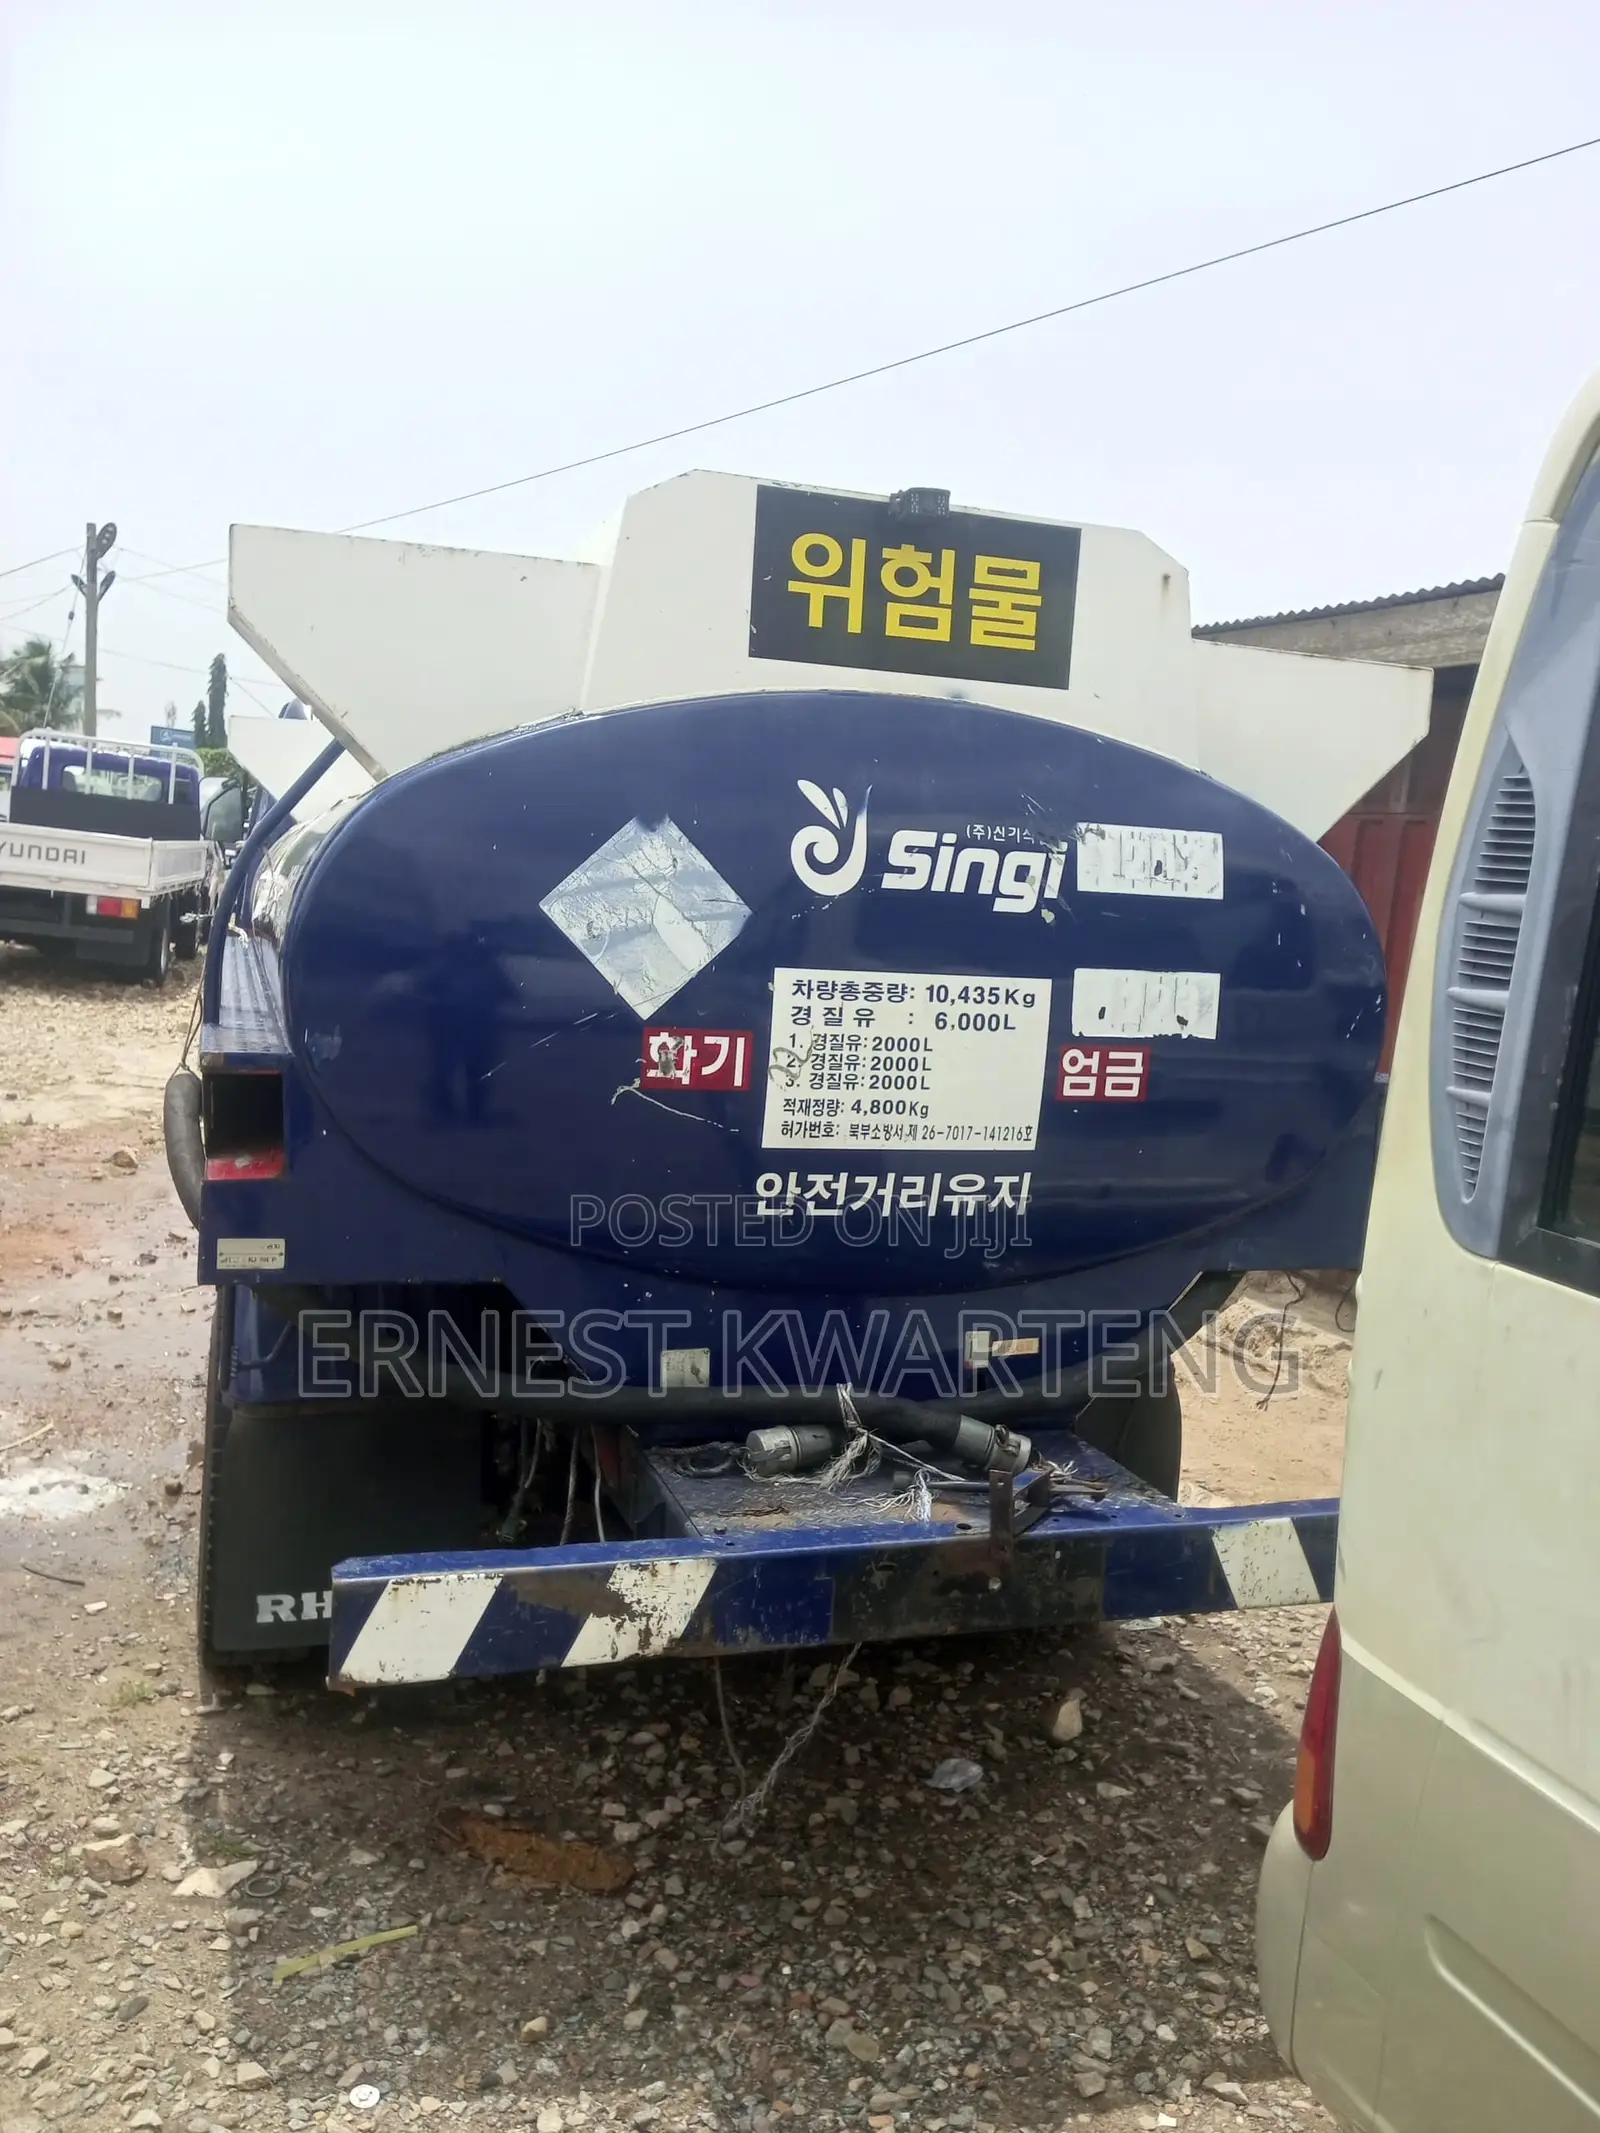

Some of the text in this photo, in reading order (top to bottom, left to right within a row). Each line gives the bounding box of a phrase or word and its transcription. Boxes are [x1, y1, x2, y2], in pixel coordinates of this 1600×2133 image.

[787, 532, 1043, 651] 위험물
[791, 979, 1036, 1008] 차량총중량: 10,435Kg
[934, 1011, 1016, 1032] 6,000L
[646, 1031, 745, 1087] 화기
[1062, 1048, 1144, 1098] 엄금
[782, 1097, 930, 1119] 적재정량: 4,800Kg
[780, 1120, 841, 1140] 허가번호:
[755, 1171, 1033, 1217] 안전거리유지
